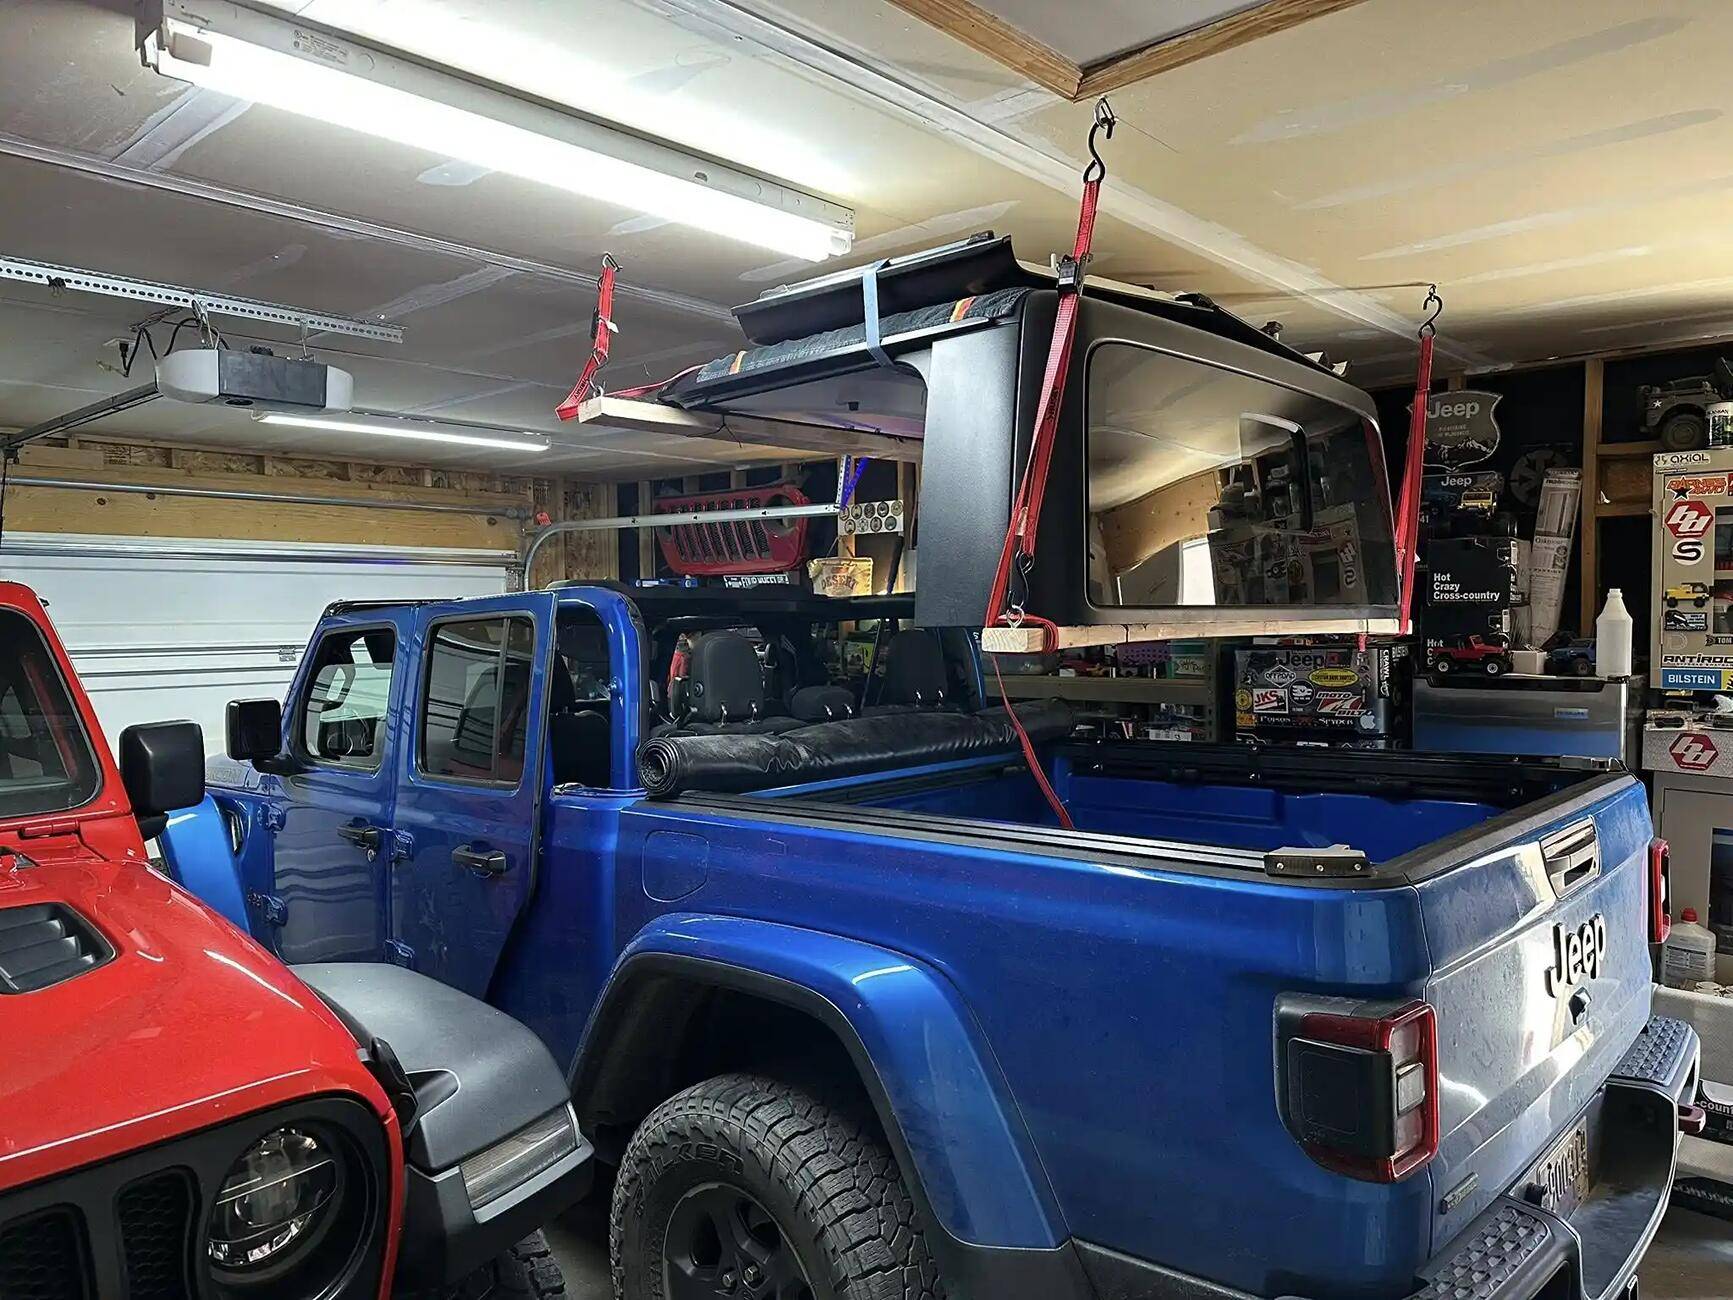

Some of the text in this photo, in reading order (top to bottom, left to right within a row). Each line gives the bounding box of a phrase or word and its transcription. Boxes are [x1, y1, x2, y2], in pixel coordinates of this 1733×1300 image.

[1428, 401, 1480, 419] Jeep
[1441, 477, 1472, 487] Jeep
[1433, 573, 1451, 582] Hot
[1433, 582, 1460, 592] Crazy
[1433, 592, 1501, 602] Cross-country
[1280, 651, 1325, 669] Jeep
[1668, 675, 1716, 684] BILSTEIN
[1544, 913, 1607, 998] Jeep
